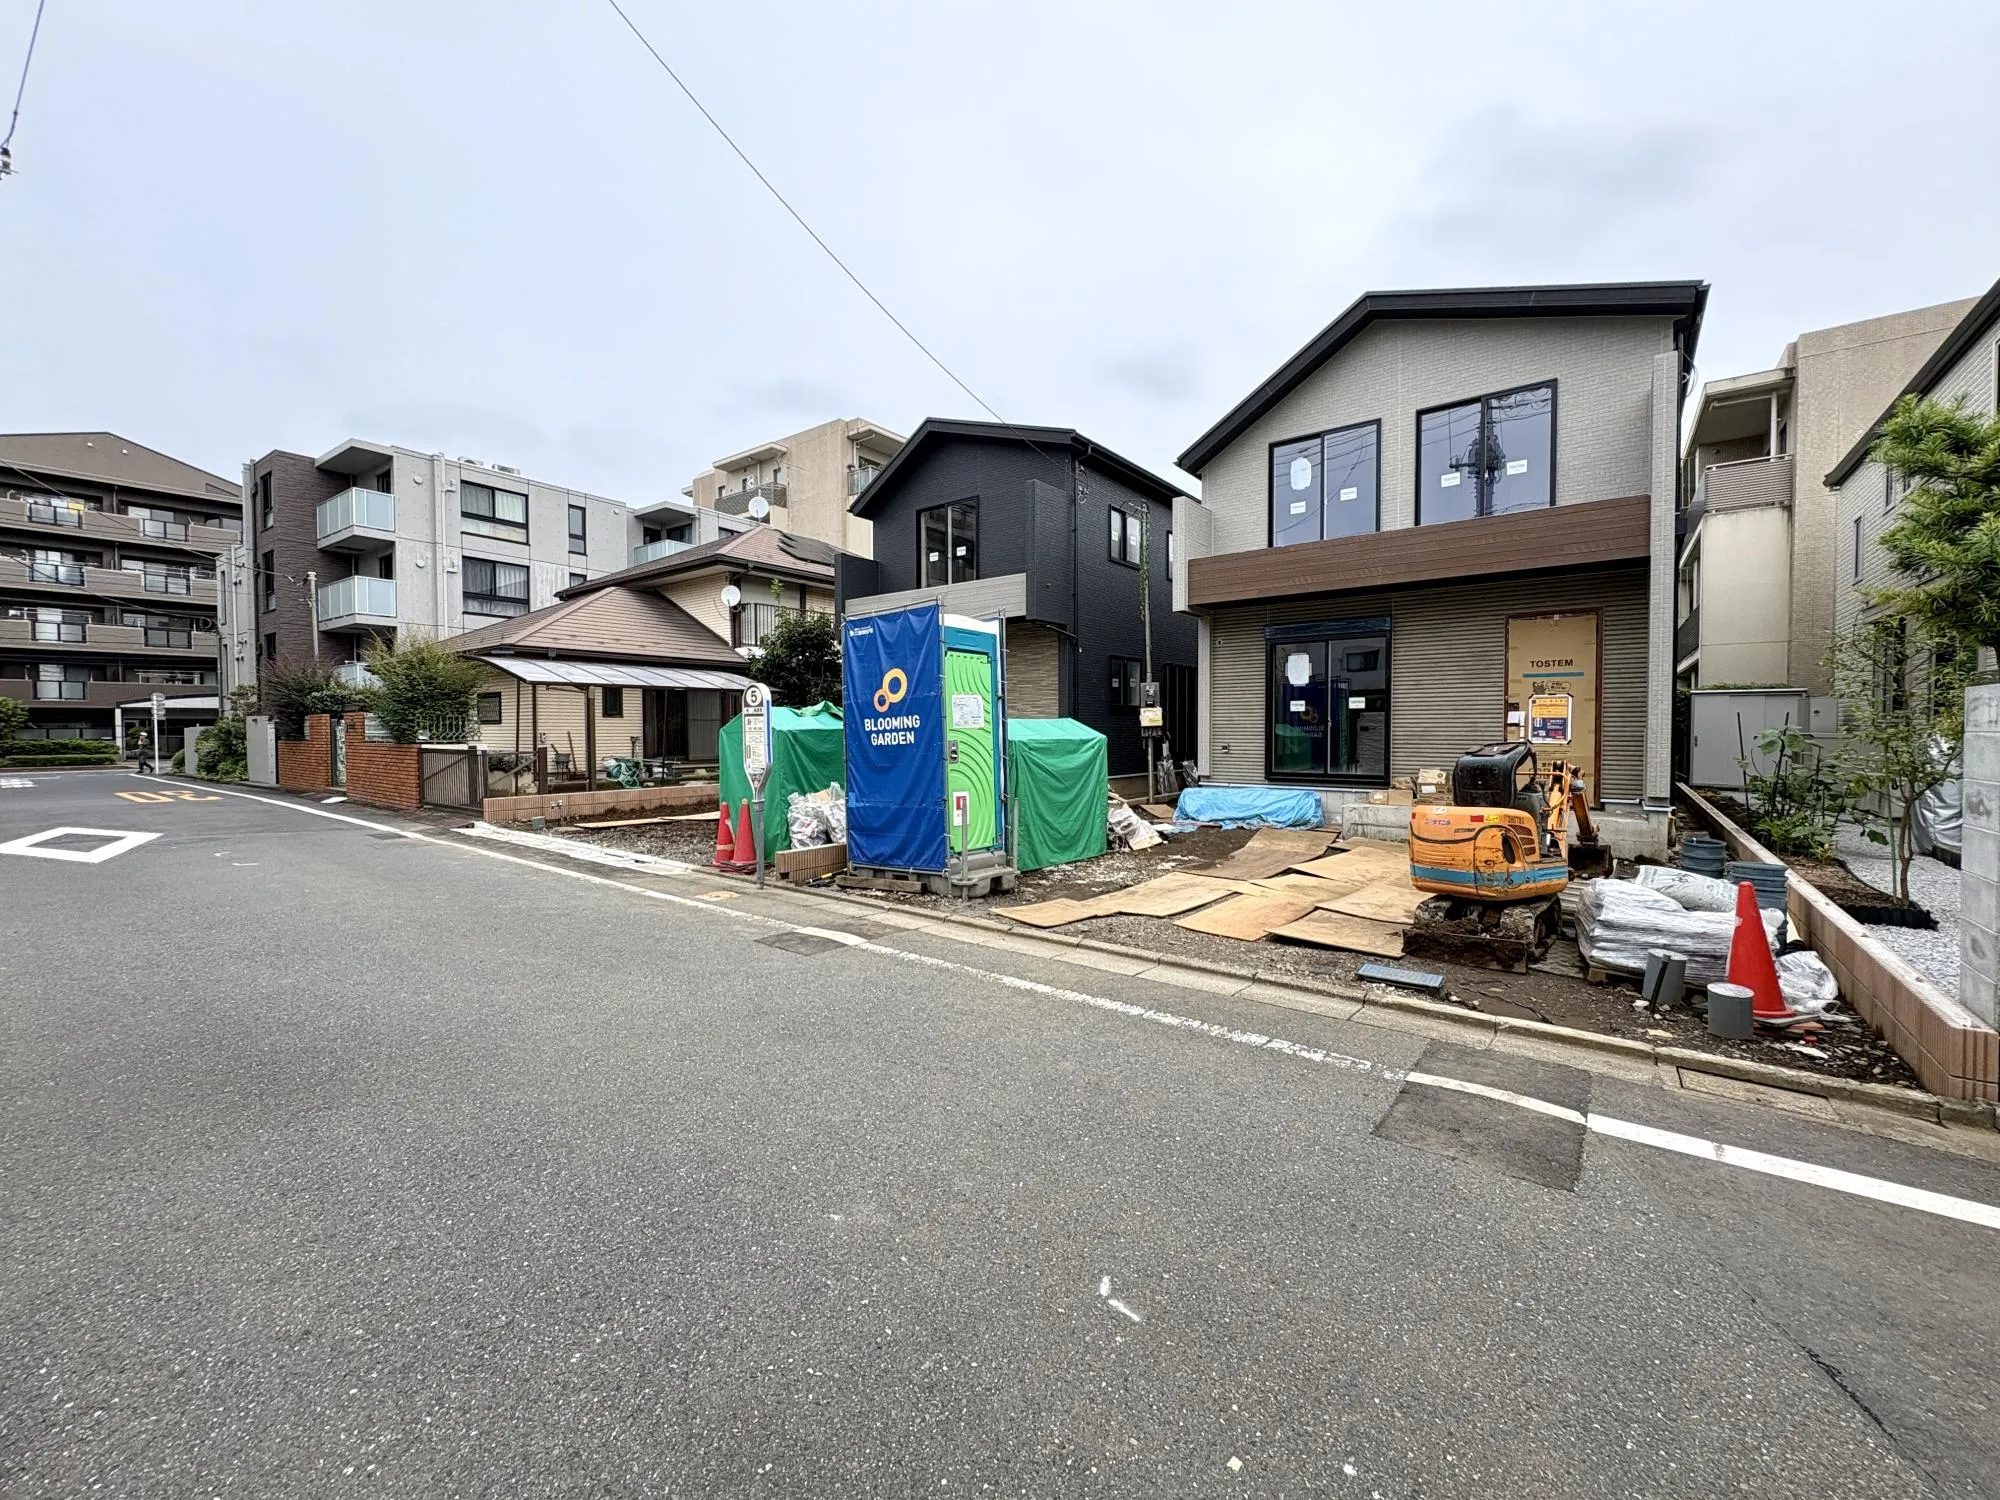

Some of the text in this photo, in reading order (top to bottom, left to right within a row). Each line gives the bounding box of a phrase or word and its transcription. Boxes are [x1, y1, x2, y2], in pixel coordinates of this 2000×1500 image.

[1530, 658, 1574, 668] TOSTEM
[750, 690, 758, 703] 5
[864, 714, 920, 731] BLOOMING
[871, 730, 915, 746] GARDEN
